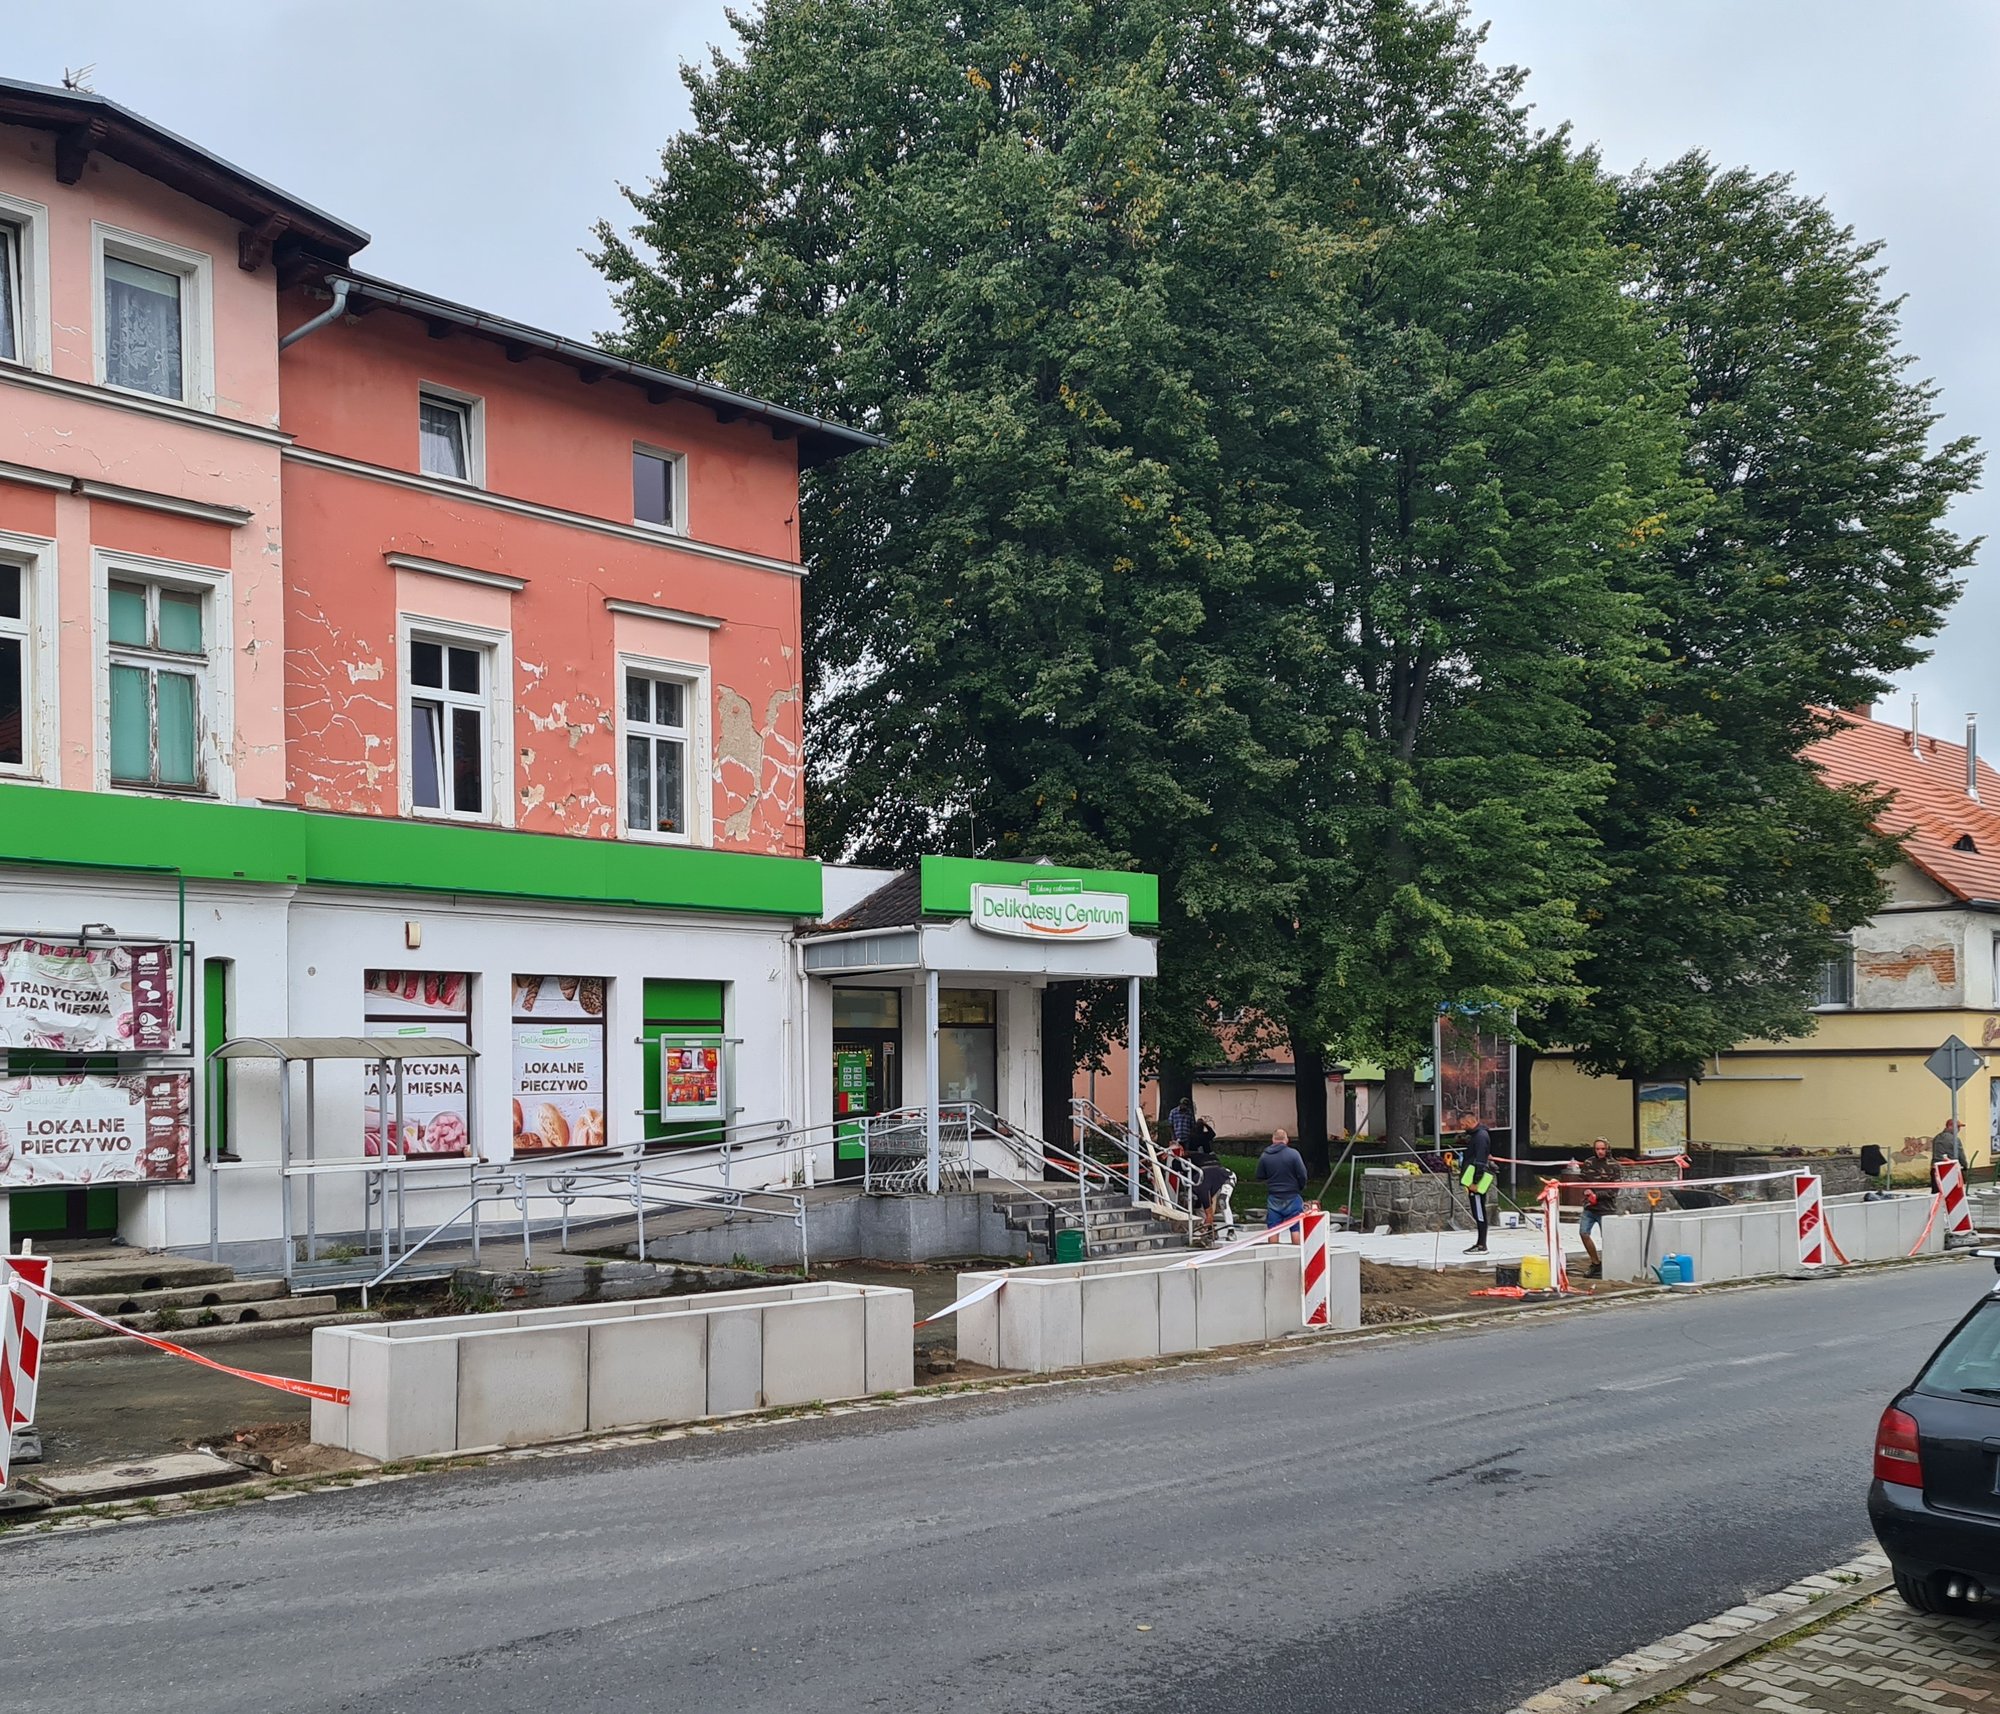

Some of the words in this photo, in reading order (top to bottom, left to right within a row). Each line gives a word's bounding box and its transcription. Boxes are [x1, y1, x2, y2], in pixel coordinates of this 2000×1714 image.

[983, 896, 1062, 927] Delikatesy
[1065, 903, 1124, 925] Centrum
[10, 981, 109, 1002] TRADYCYJNA
[6, 996, 50, 1010] LADA
[54, 1001, 111, 1017] MIĘSNA
[364, 1064, 461, 1076] TRAYCYJNA
[525, 1062, 585, 1074] LOKALNE
[408, 1081, 464, 1097] MIĘSNA
[521, 1079, 588, 1092] PIECZYWO
[27, 1117, 126, 1136] LOKALNE
[21, 1136, 132, 1156] PIECZYWO
